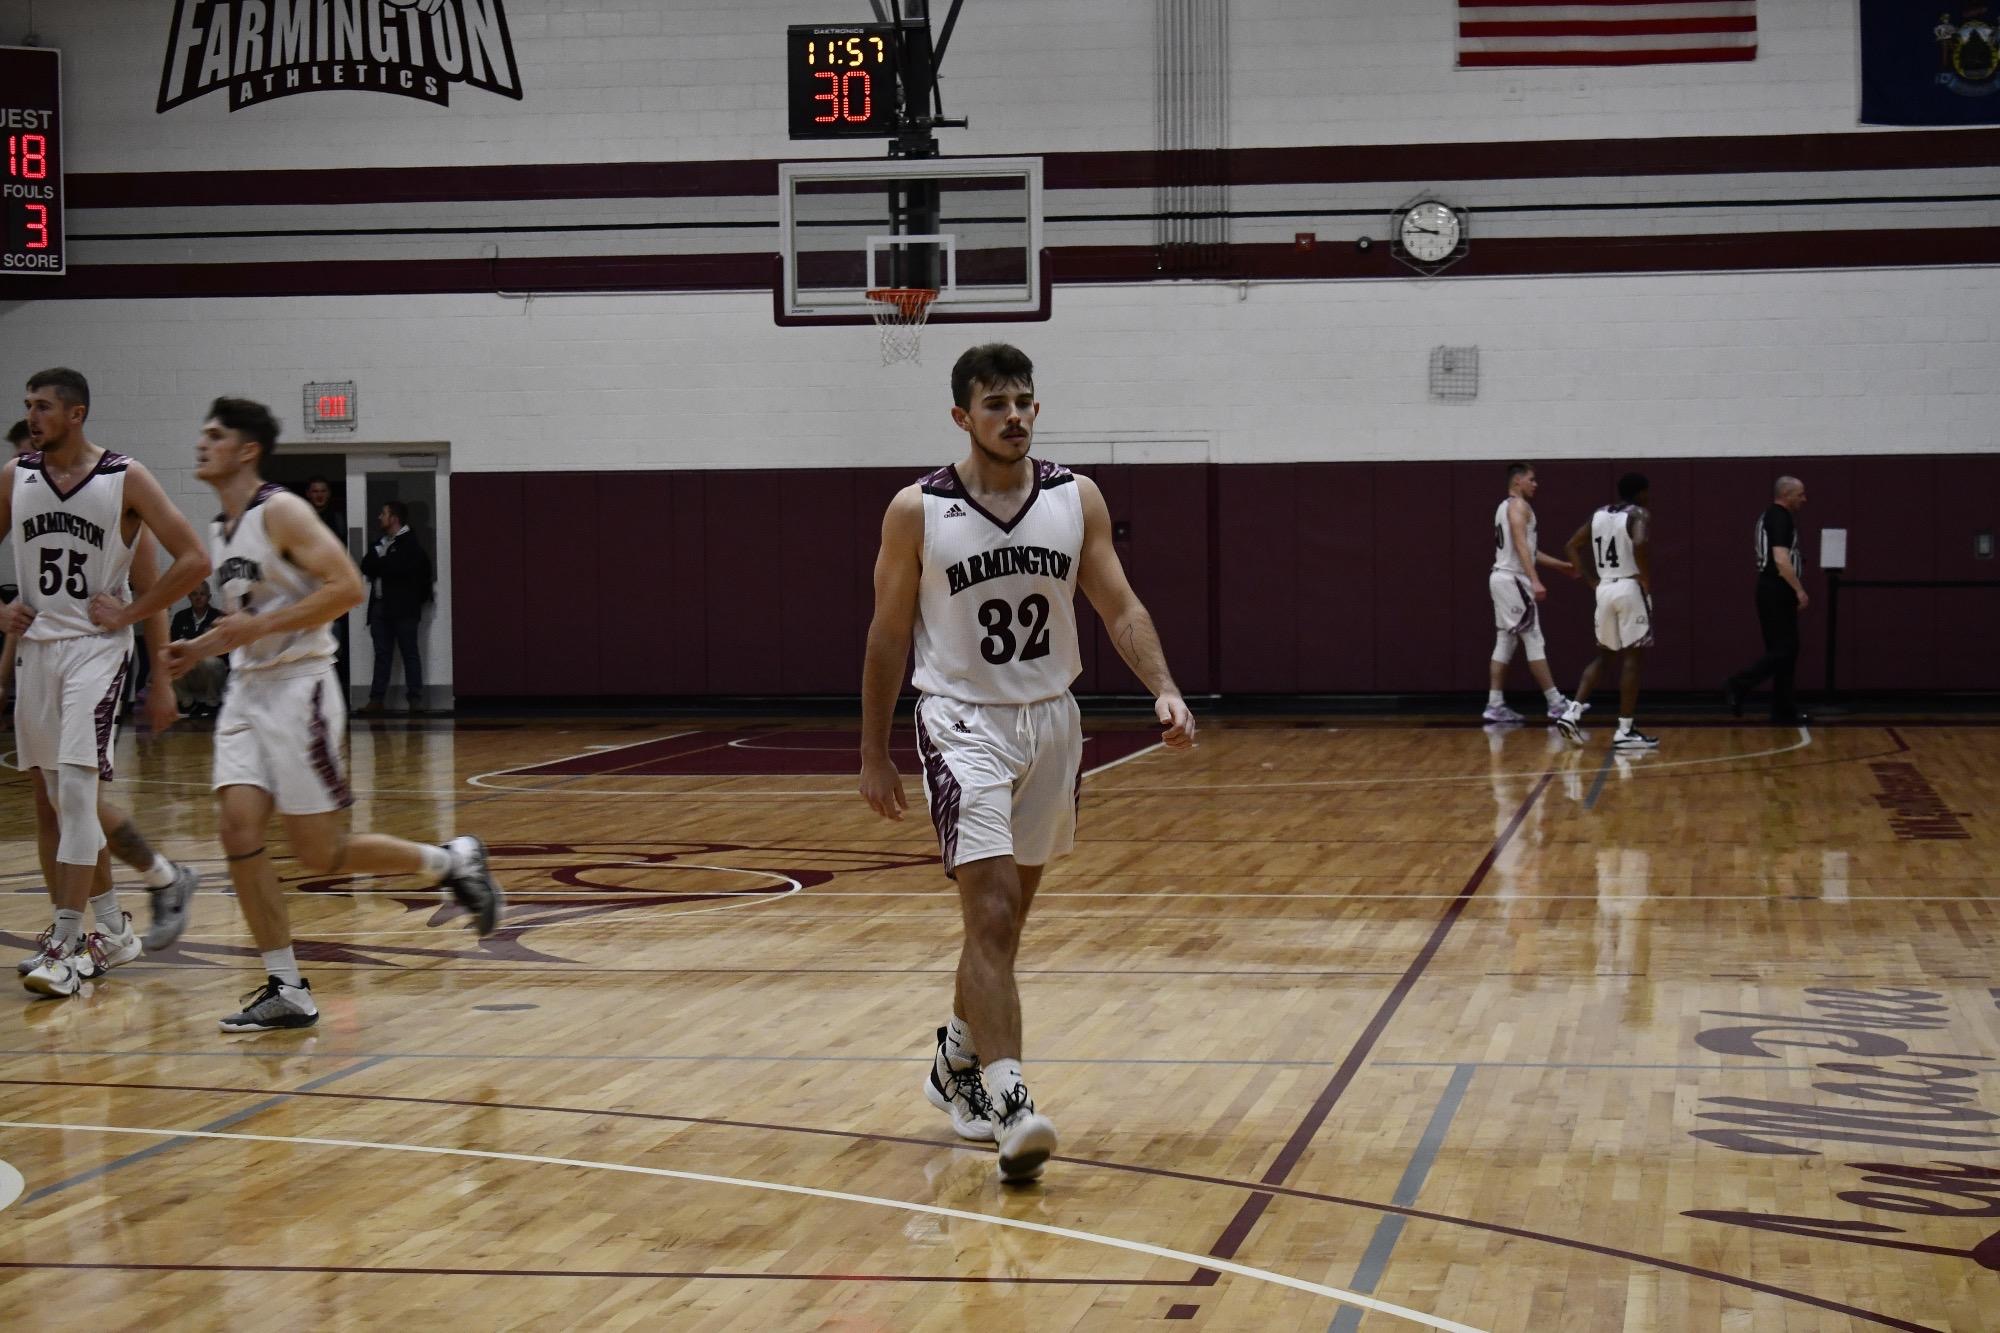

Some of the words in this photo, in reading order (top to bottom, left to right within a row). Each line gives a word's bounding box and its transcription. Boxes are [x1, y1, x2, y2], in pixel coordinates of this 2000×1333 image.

[166, 0, 514, 102] FARMINGTON
[808, 37, 884, 66] 11:57
[240, 65, 438, 103] ATHLETICS
[814, 71, 871, 122] 30
[9, 134, 46, 178] 18
[3, 184, 54, 199] FOULS
[25, 204, 48, 248] 3
[3, 254, 59, 268] SCORE
[22, 512, 105, 551] FARMINGTON
[1595, 536, 1619, 568] 14
[39, 547, 88, 600] 55
[946, 546, 1072, 596] FARMINGTON
[978, 594, 1050, 665] 32
